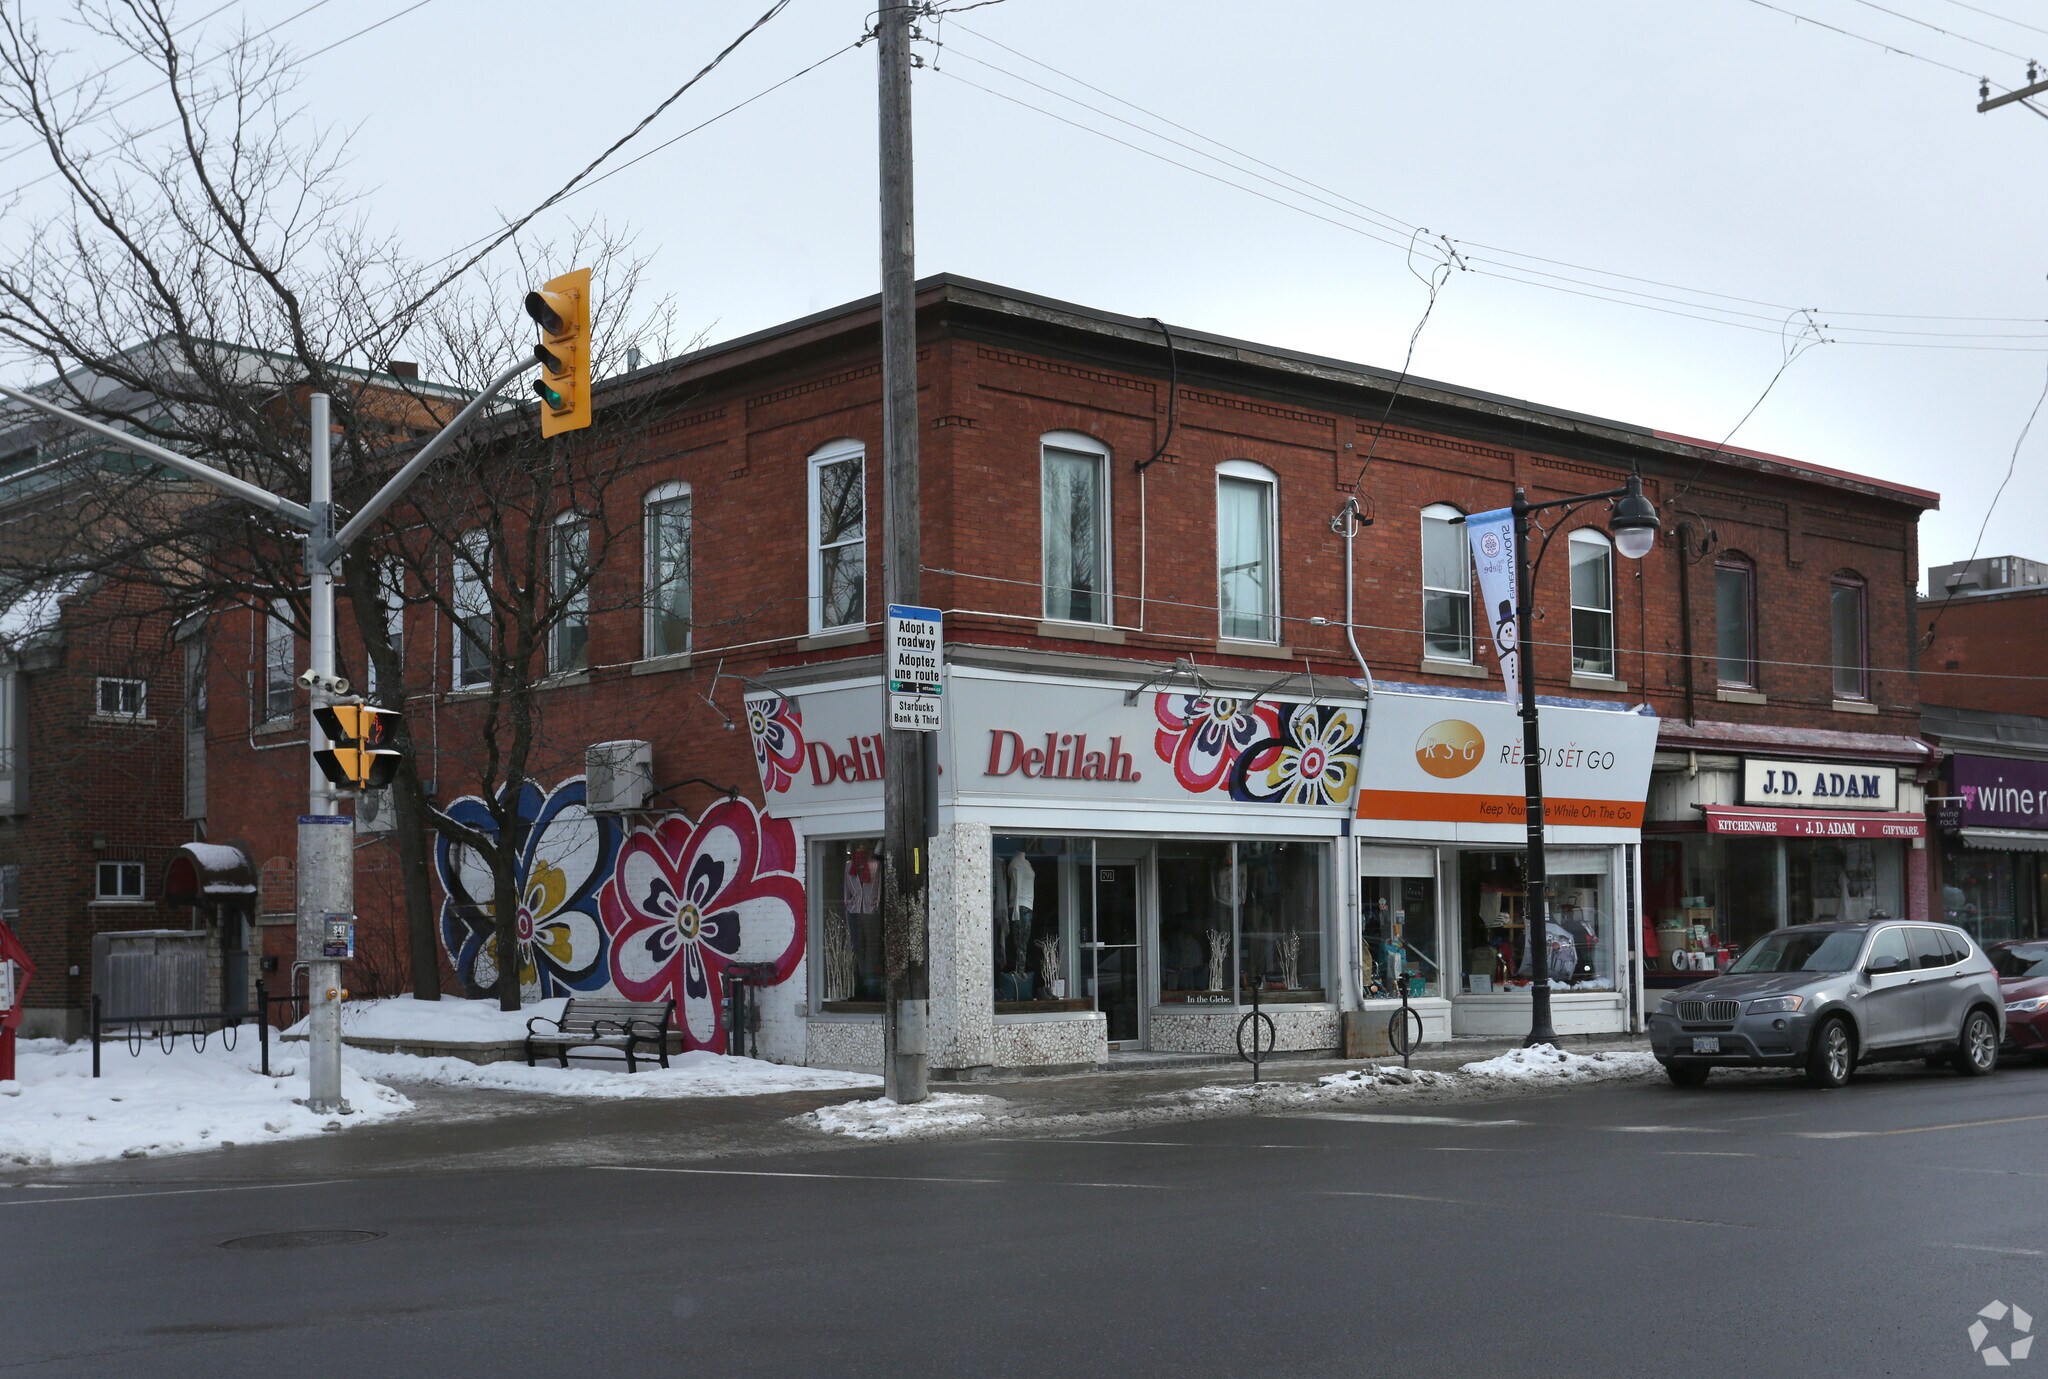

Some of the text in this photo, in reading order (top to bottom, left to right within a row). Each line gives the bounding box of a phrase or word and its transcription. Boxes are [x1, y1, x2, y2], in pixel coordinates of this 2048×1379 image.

[899, 620, 934, 636] Adopt a
[897, 635, 936, 651] roadway
[898, 652, 935, 669] Adoptez
[894, 668, 940, 682] une route
[899, 701, 935, 713] Starbucks
[894, 713, 939, 725] Bank & Third
[983, 728, 1142, 783] Delilah.
[1587, 750, 1615, 770] GO
[1812, 772, 1881, 799] ADAM
[1977, 776, 2034, 815] wine
[1480, 801, 1503, 816] Keep
[1553, 805, 1579, 818] While
[1582, 806, 1597, 818] On
[1599, 807, 1615, 819] The
[1617, 808, 1632, 820] Go
[1939, 810, 1959, 818] wine
[1718, 820, 1777, 832] KITCHENWARE
[1940, 818, 1958, 826] rack
[1828, 823, 1856, 835] ADAM
[1882, 826, 1919, 835] GIFTWARE
[1102, 871, 1112, 880] 791
[1187, 995, 1232, 1004] In the Glebe.
